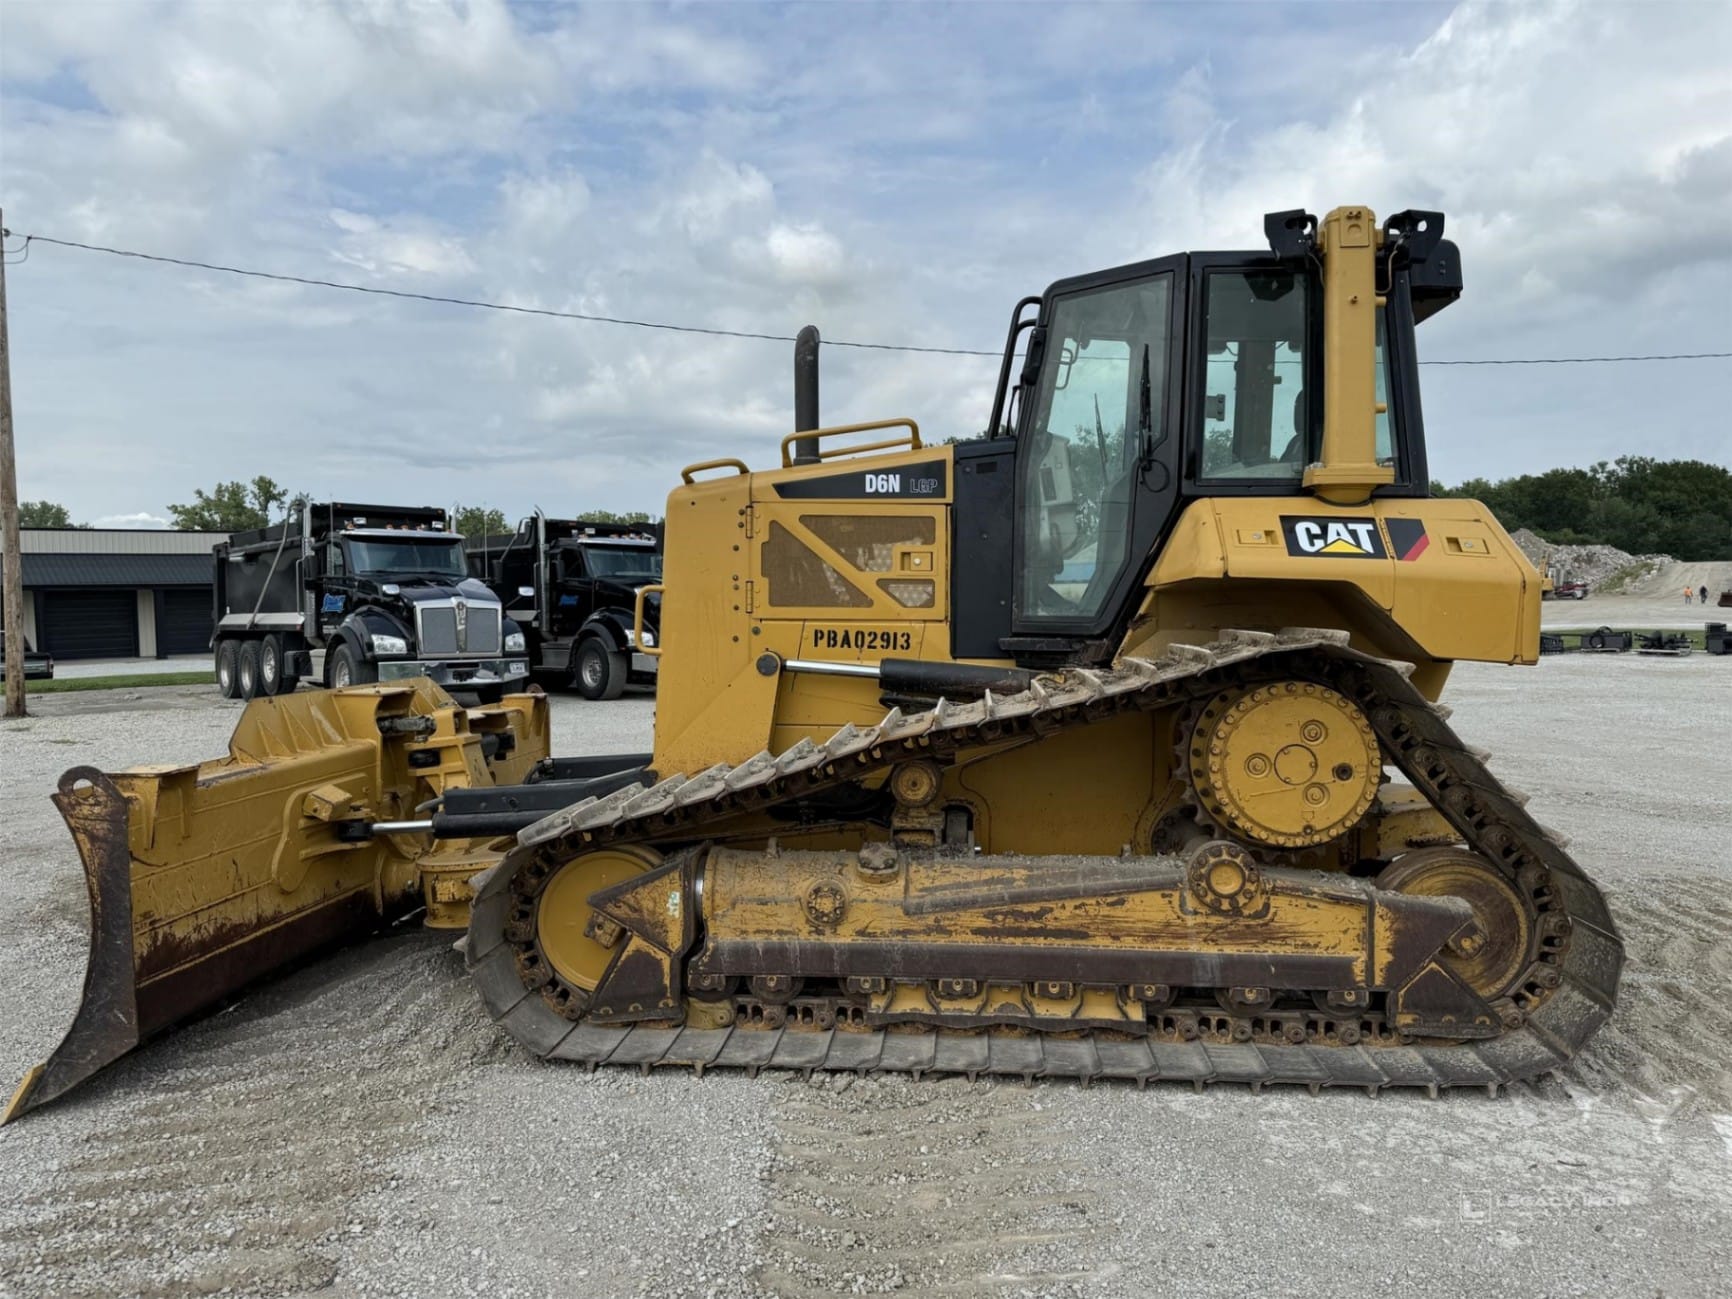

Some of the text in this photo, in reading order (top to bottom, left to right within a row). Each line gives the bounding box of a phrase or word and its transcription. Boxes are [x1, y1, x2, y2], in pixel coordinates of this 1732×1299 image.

[865, 474, 900, 493] D6N
[1295, 521, 1375, 554] CAT
[813, 629, 911, 650] PBA02913
